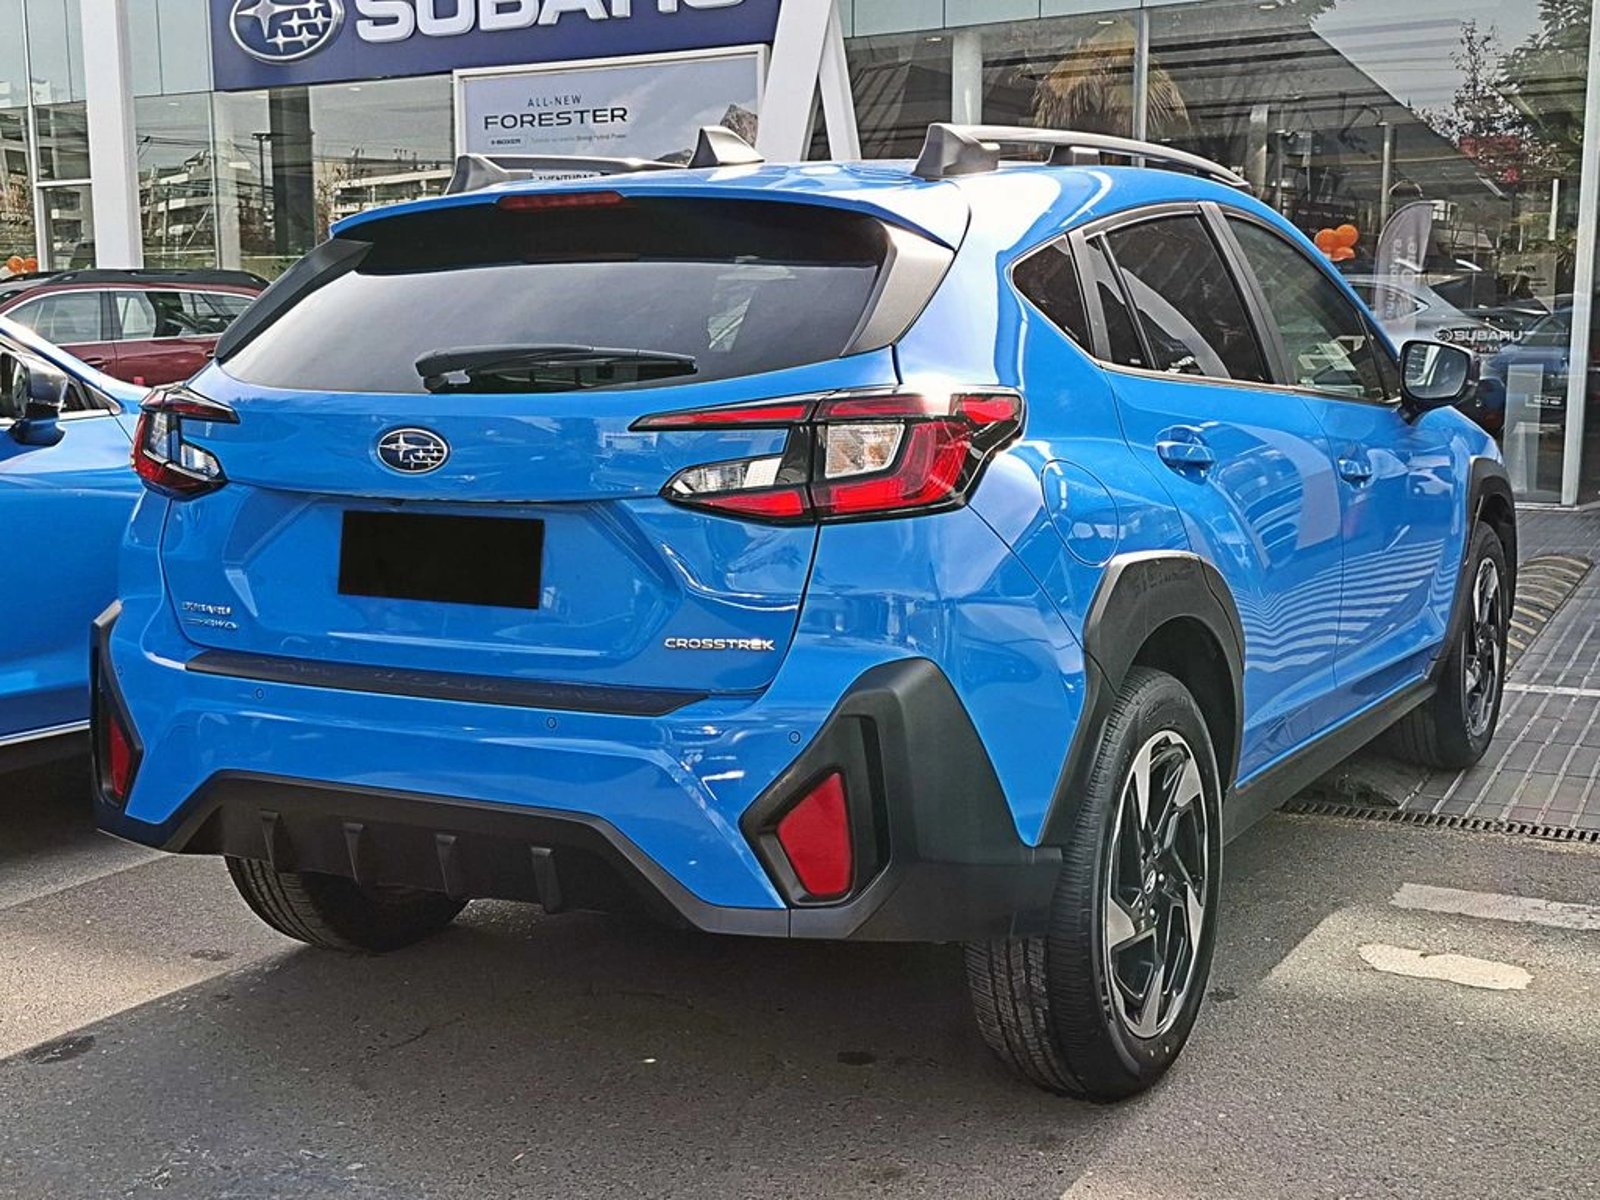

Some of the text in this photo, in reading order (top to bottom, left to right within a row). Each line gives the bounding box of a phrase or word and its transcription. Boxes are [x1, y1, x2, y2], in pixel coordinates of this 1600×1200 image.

[527, 95, 582, 108] ALL-NEW
[484, 107, 628, 130] FORESTER
[1454, 330, 1523, 341] SUBARU
[664, 638, 775, 650] CROSSTREK
